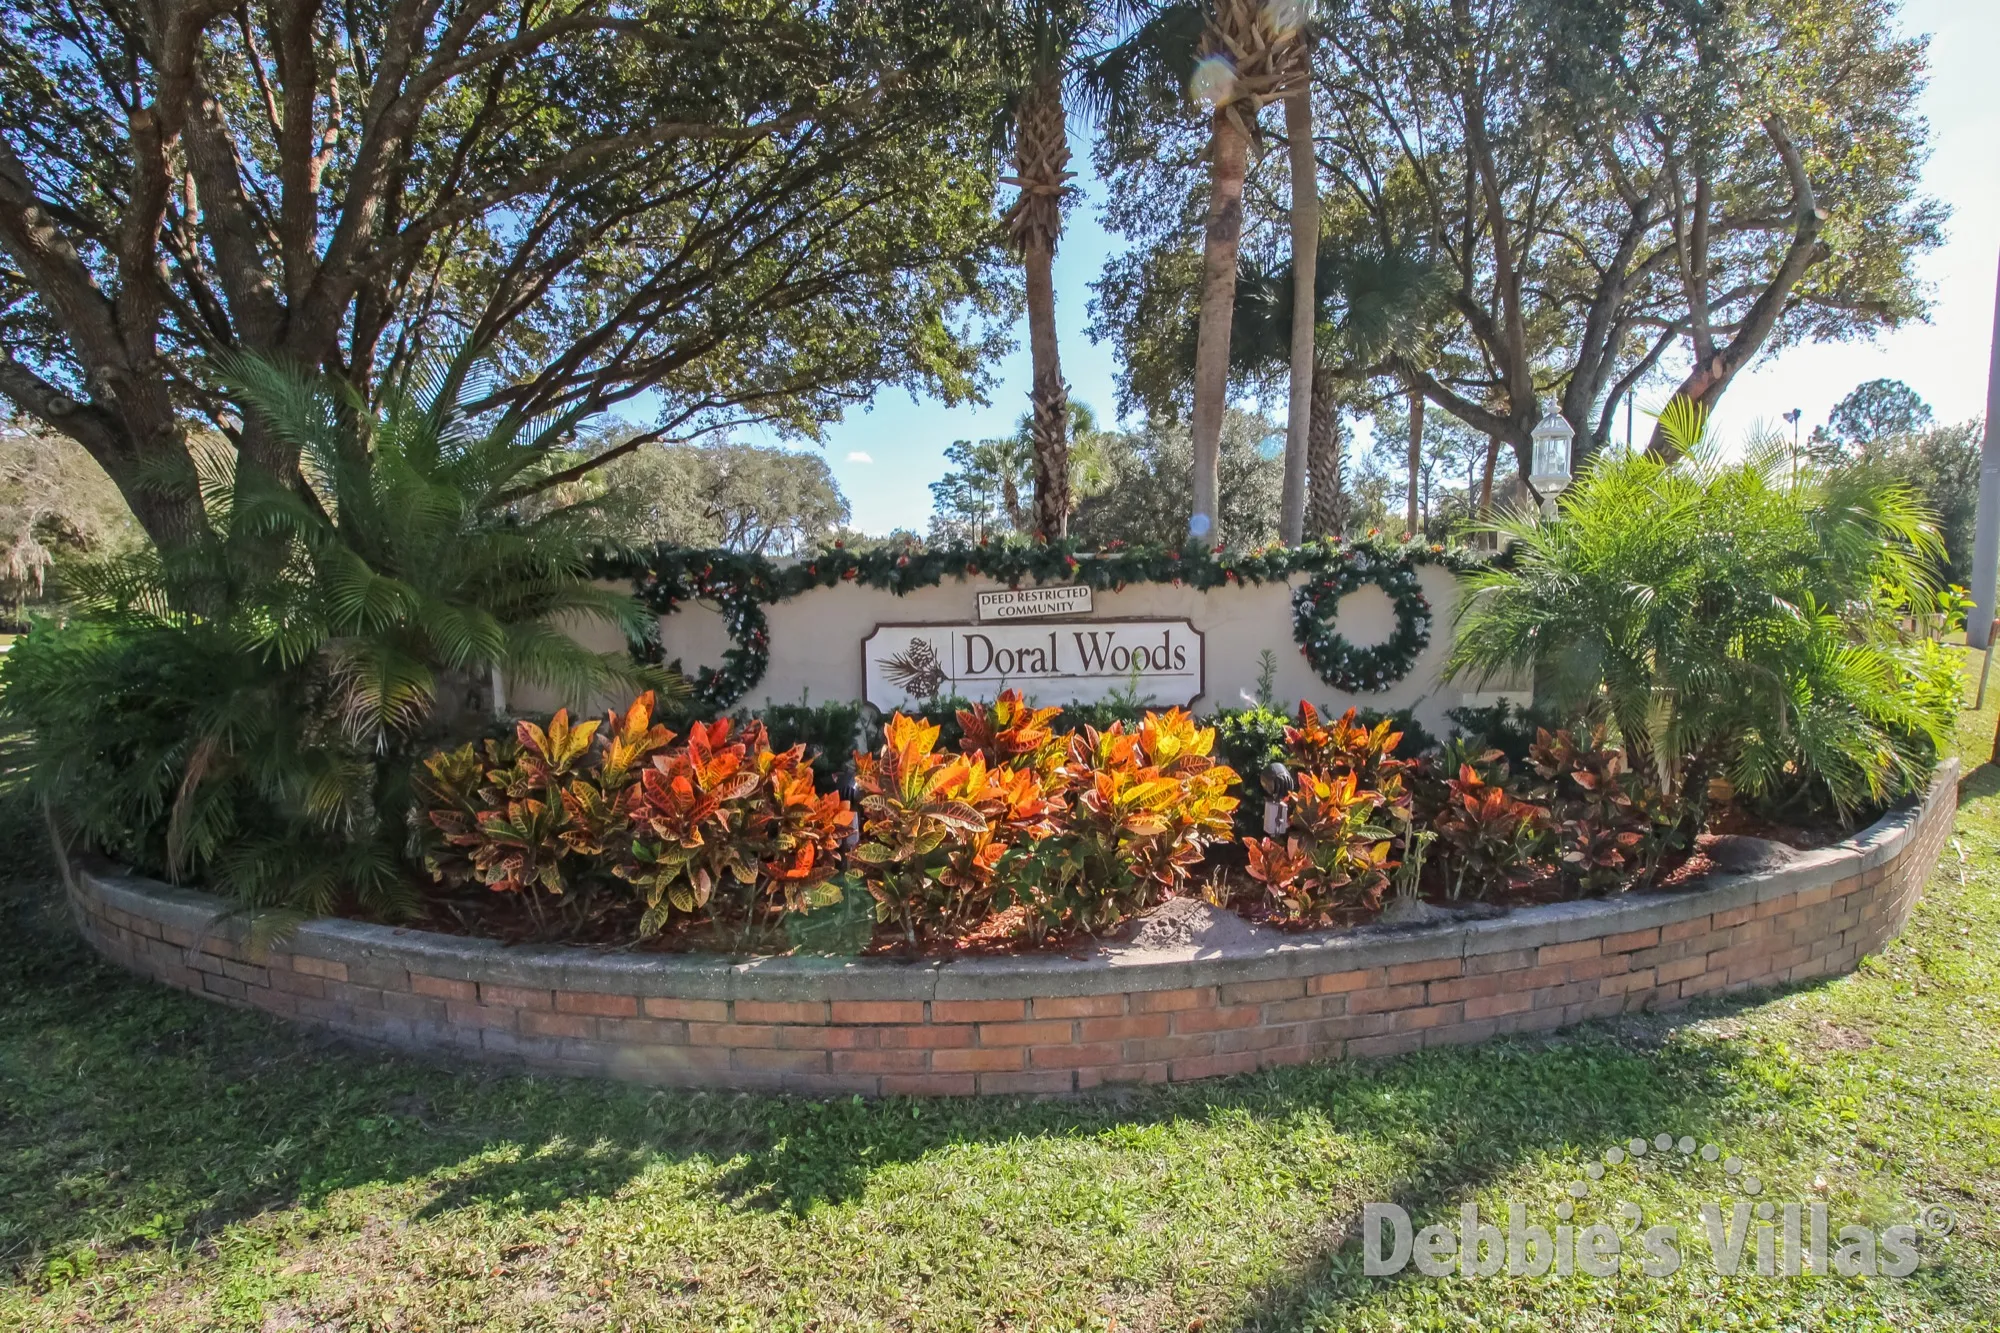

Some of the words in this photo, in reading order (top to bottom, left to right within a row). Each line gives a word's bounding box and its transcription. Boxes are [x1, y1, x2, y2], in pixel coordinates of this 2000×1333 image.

[981, 592, 1014, 605] DEED
[1017, 587, 1089, 603] RESTRICTED
[997, 601, 1075, 617] COMMUNITY
[962, 631, 1059, 676] Doral
[1073, 629, 1186, 673] Woods
